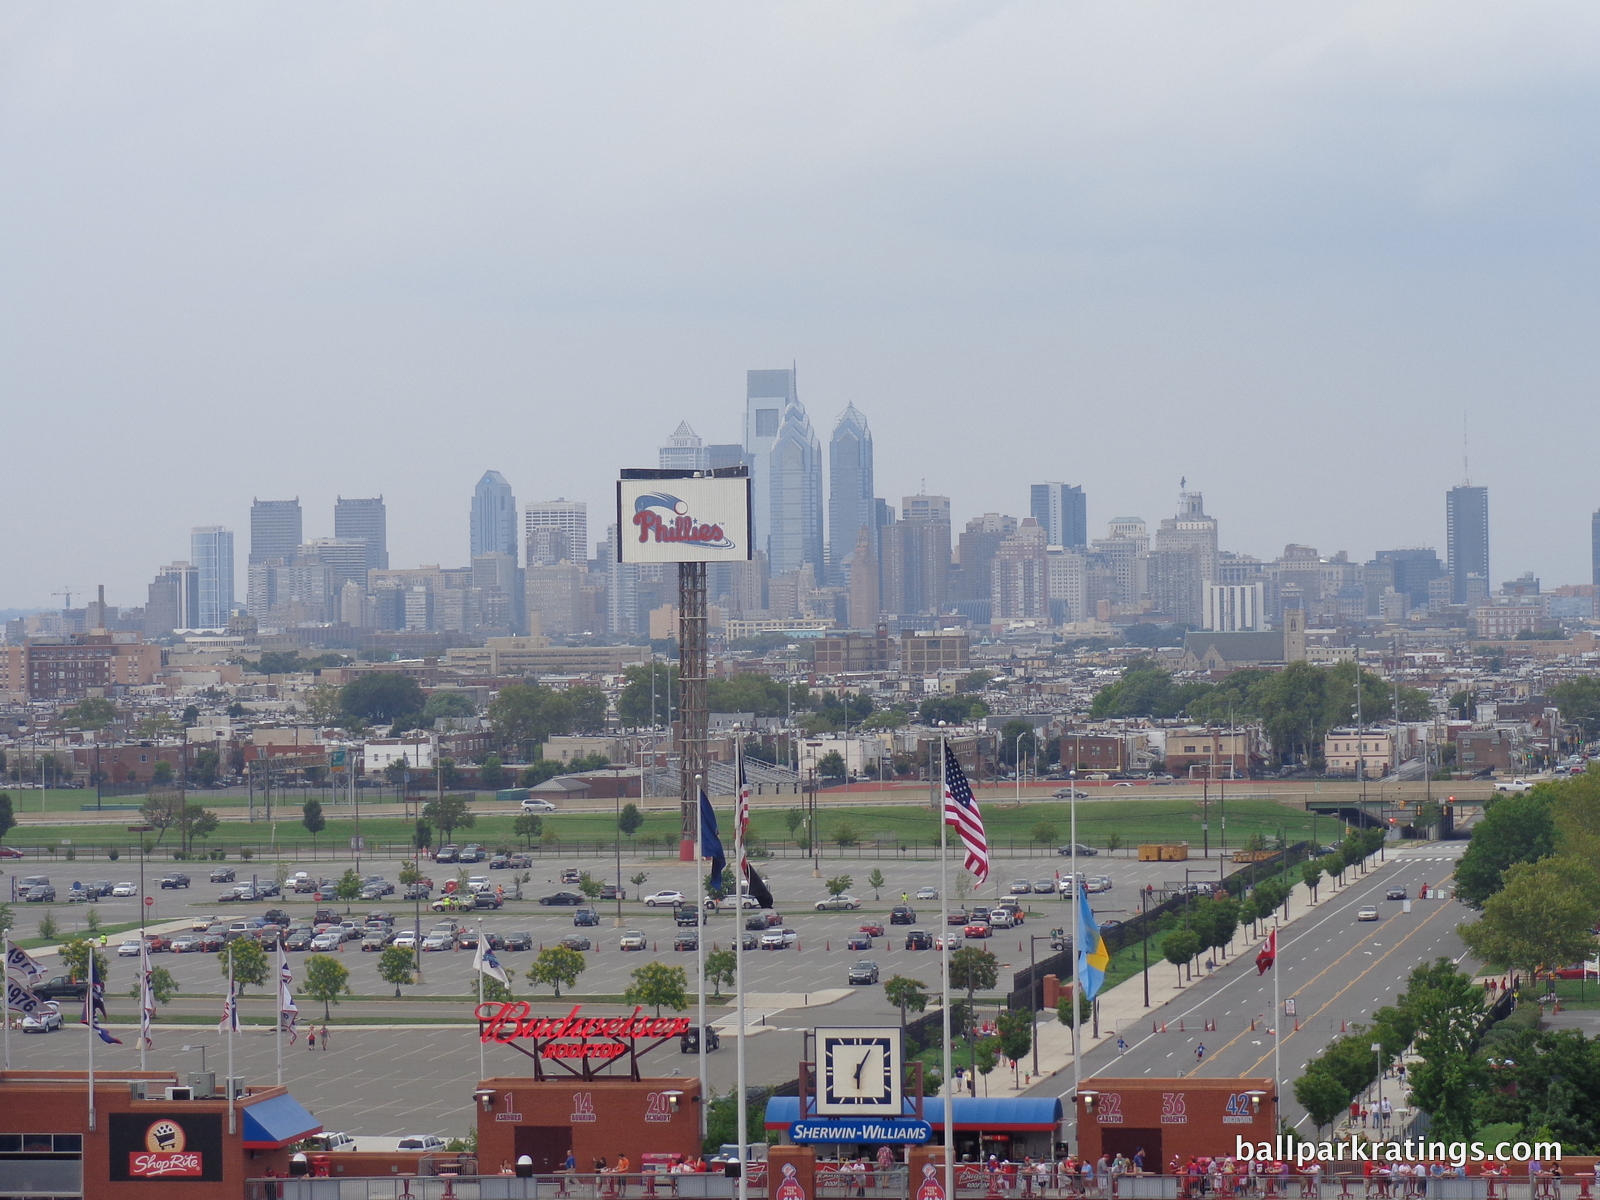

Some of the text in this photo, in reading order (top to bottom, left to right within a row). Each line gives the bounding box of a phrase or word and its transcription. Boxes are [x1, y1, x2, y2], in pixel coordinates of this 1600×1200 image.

[632, 510, 724, 543] Phillies
[475, 1001, 691, 1044] Budweiser
[541, 1043, 626, 1059] ROOFTOP
[504, 1092, 514, 1114] 1
[573, 1092, 594, 1114] 14
[646, 1092, 670, 1114] 20
[1097, 1093, 1122, 1115] 32
[1162, 1093, 1186, 1115] 36
[1226, 1093, 1250, 1115] 42
[645, 1113, 671, 1122] SCHMIDT
[1161, 1115, 1187, 1124] ROBERTS
[793, 1123, 927, 1140] SHERWIN-WILLIAMS
[133, 1154, 198, 1176] ShopRite
